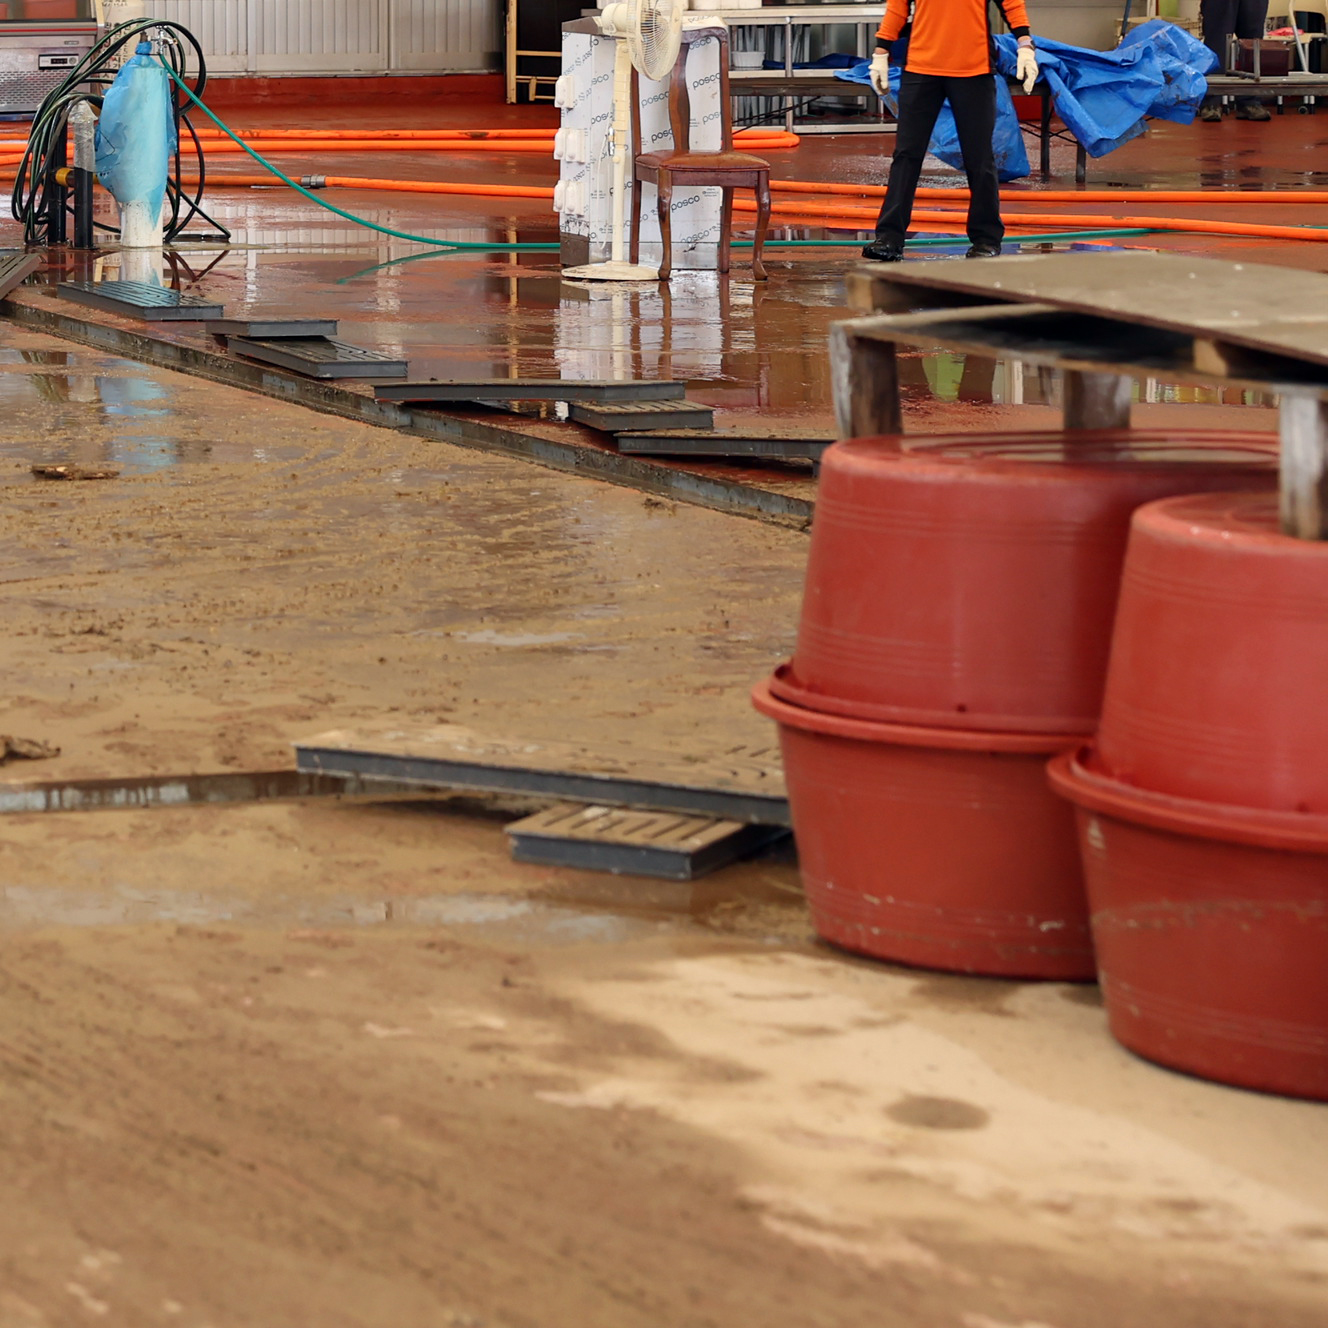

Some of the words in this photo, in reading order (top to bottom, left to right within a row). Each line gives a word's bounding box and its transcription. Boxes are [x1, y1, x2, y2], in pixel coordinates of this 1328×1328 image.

[689, 36, 712, 50] osco
[591, 73, 610, 86] sco
[702, 111, 720, 125] pos
[651, 128, 673, 144] posc
[671, 195, 701, 212] posco
